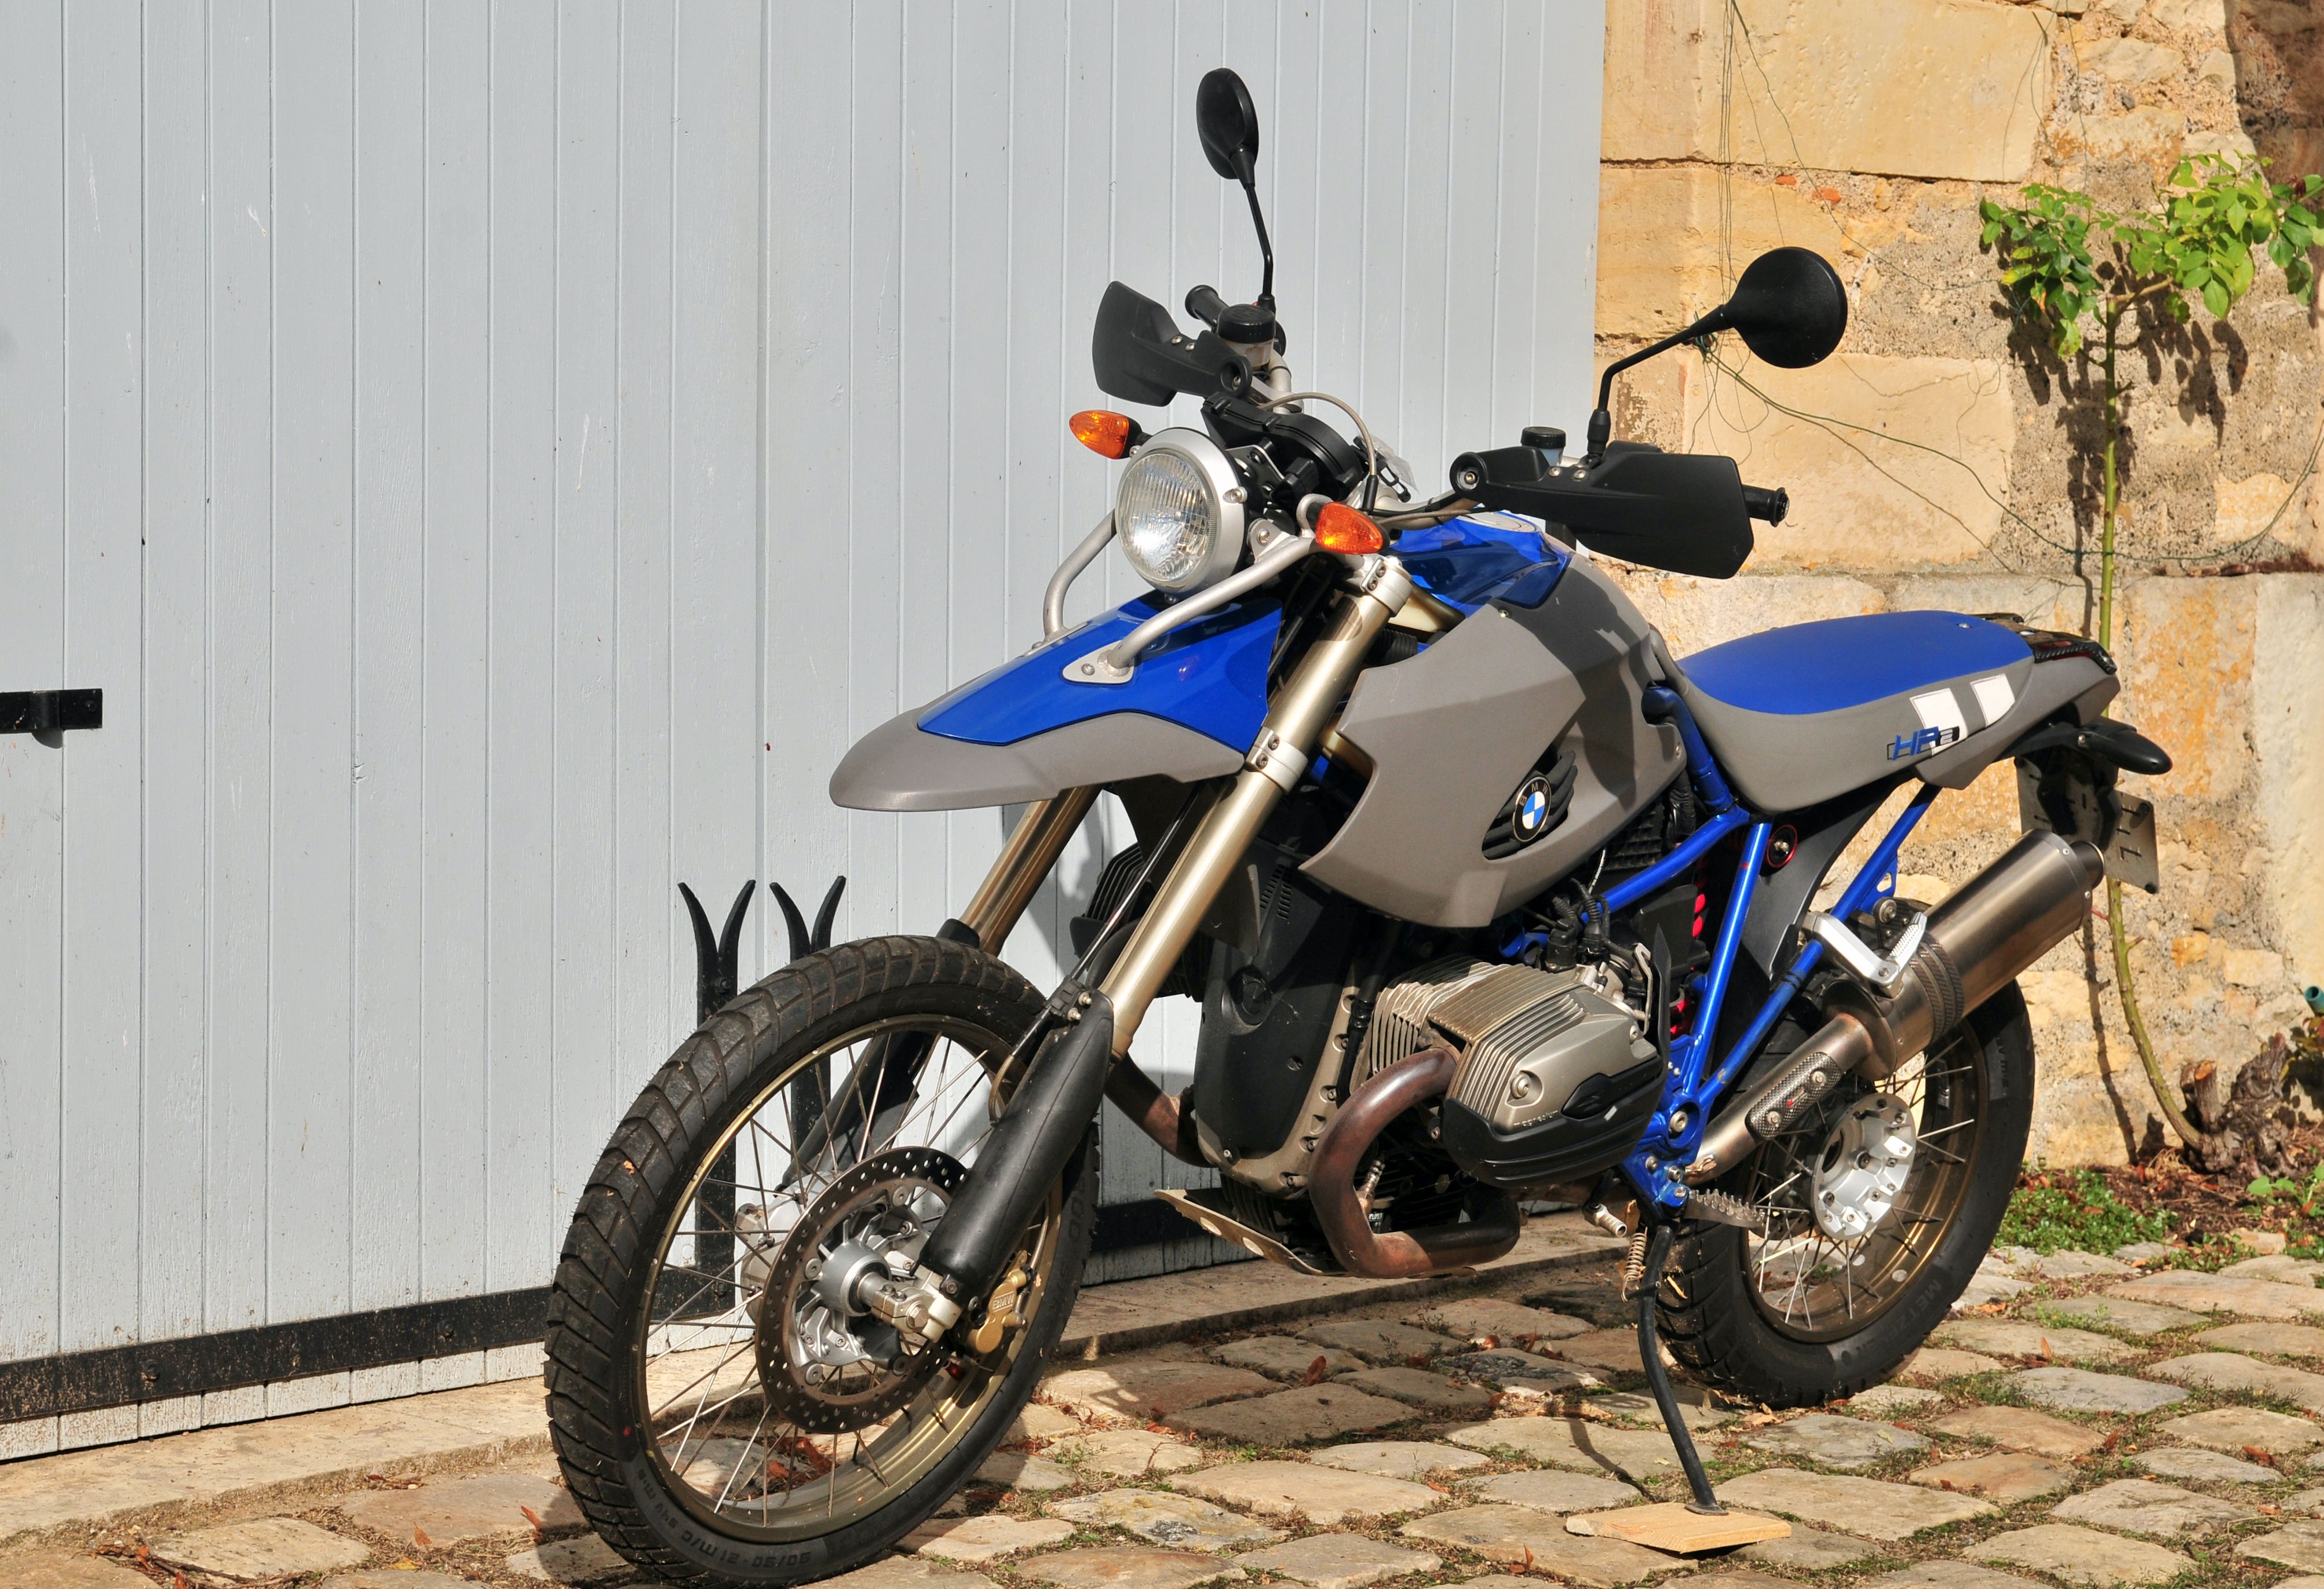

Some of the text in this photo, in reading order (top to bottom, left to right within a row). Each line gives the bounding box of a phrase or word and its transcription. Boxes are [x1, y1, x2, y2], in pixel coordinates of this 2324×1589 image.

[1891, 725, 1954, 761] HP2
[1519, 781, 1549, 806] BMW
[992, 1294, 1015, 1310] BMW
